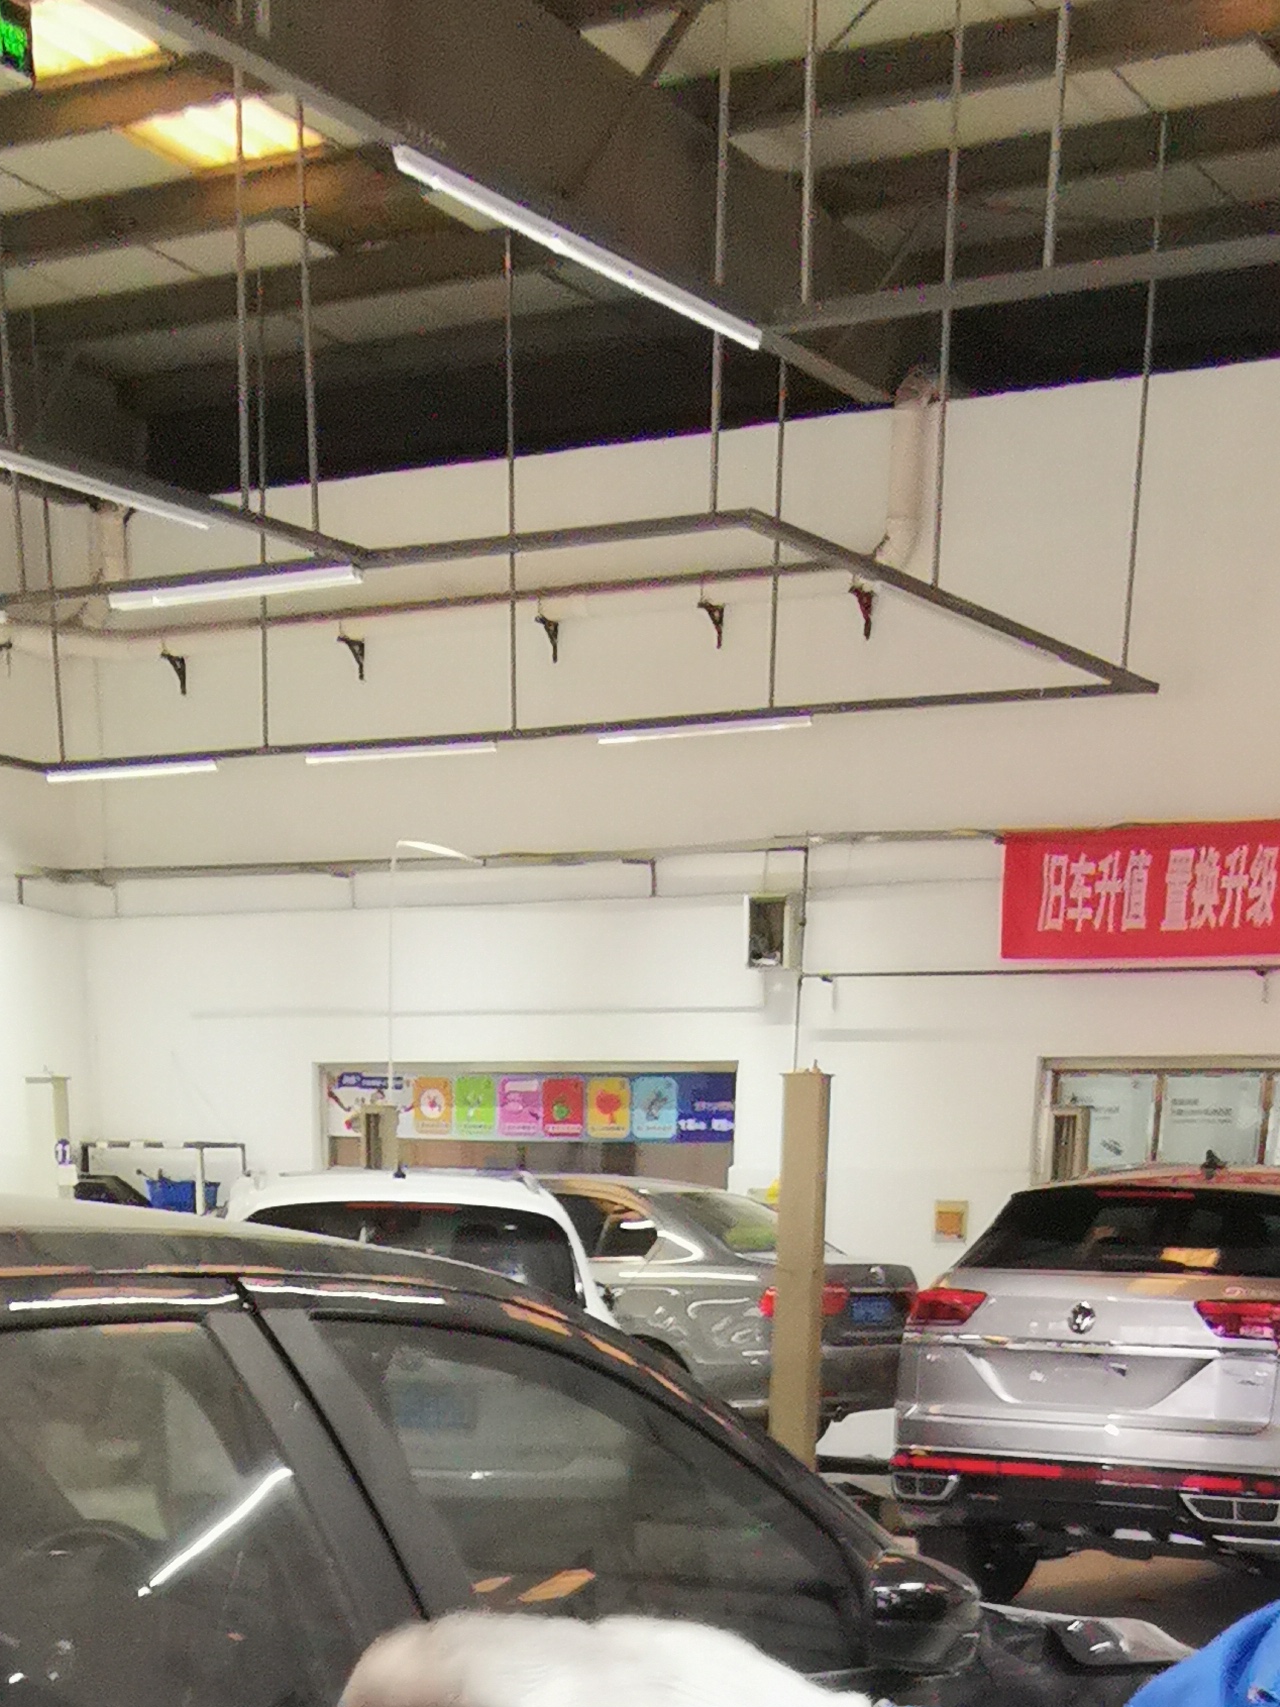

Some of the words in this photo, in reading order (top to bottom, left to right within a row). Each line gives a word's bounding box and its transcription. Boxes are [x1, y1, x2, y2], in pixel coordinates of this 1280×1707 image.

[1037, 848, 1152, 931] 旧车升值
[1160, 843, 1279, 931] 置换升级
